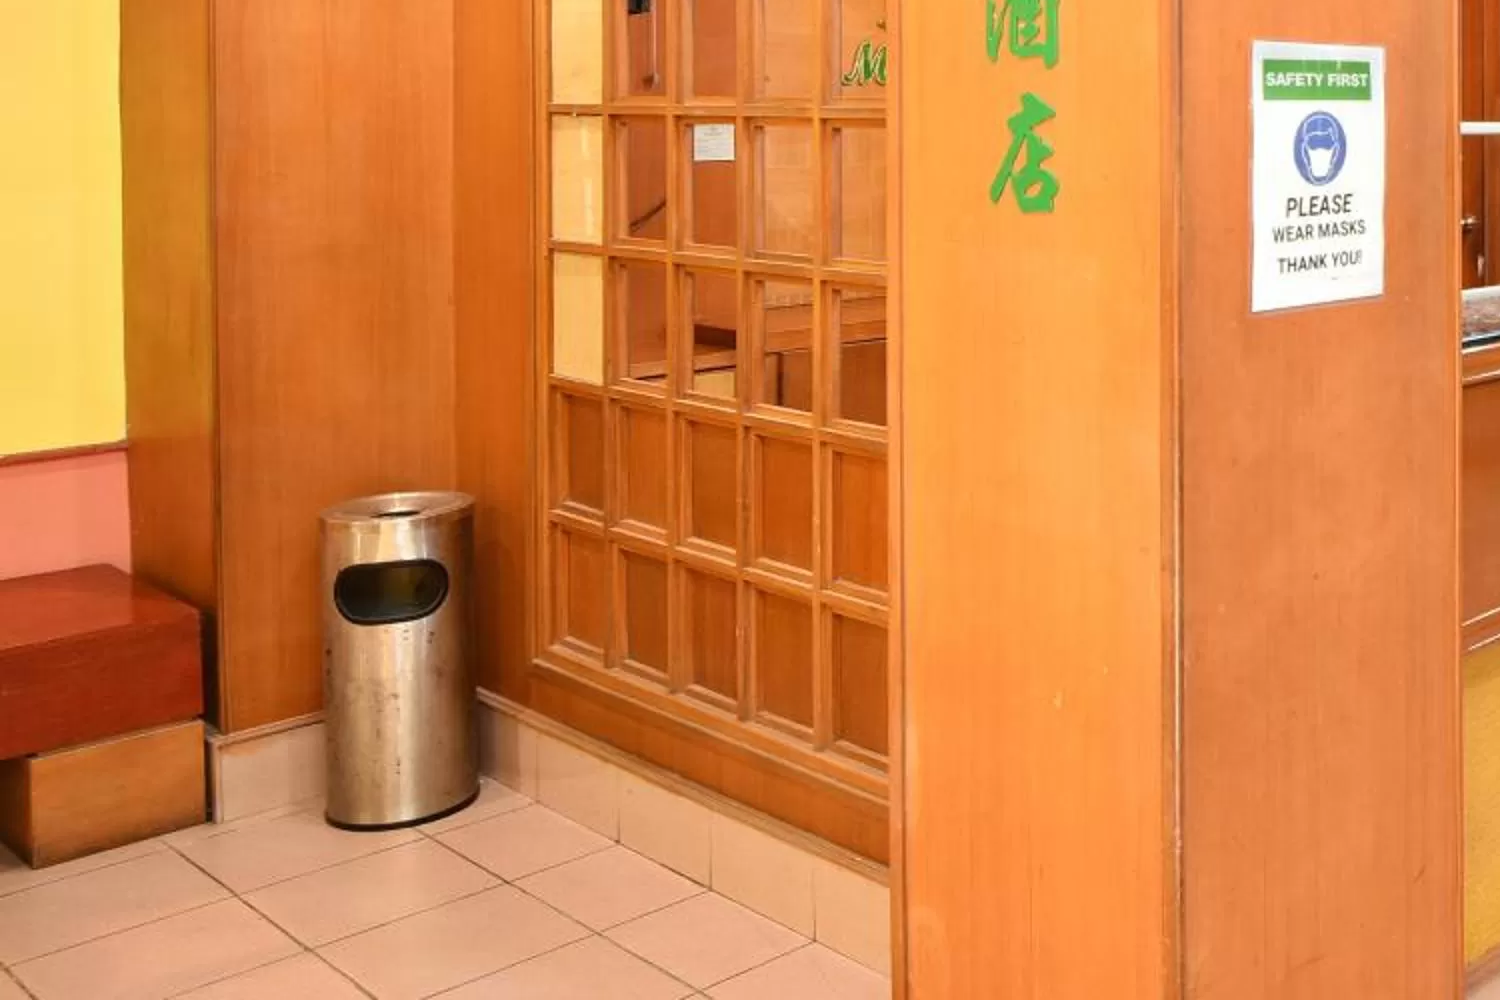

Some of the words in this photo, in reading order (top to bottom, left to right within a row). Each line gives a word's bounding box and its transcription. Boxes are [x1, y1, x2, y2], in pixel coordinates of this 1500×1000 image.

[1266, 72, 1323, 87] SAFETY
[1327, 73, 1368, 87] FIRST
[1286, 193, 1353, 218] PLEASE
[1272, 223, 1314, 243] WEAR
[1318, 219, 1366, 238] MASKS
[1278, 253, 1327, 274] THANK
[1331, 249, 1362, 267] YOU!
